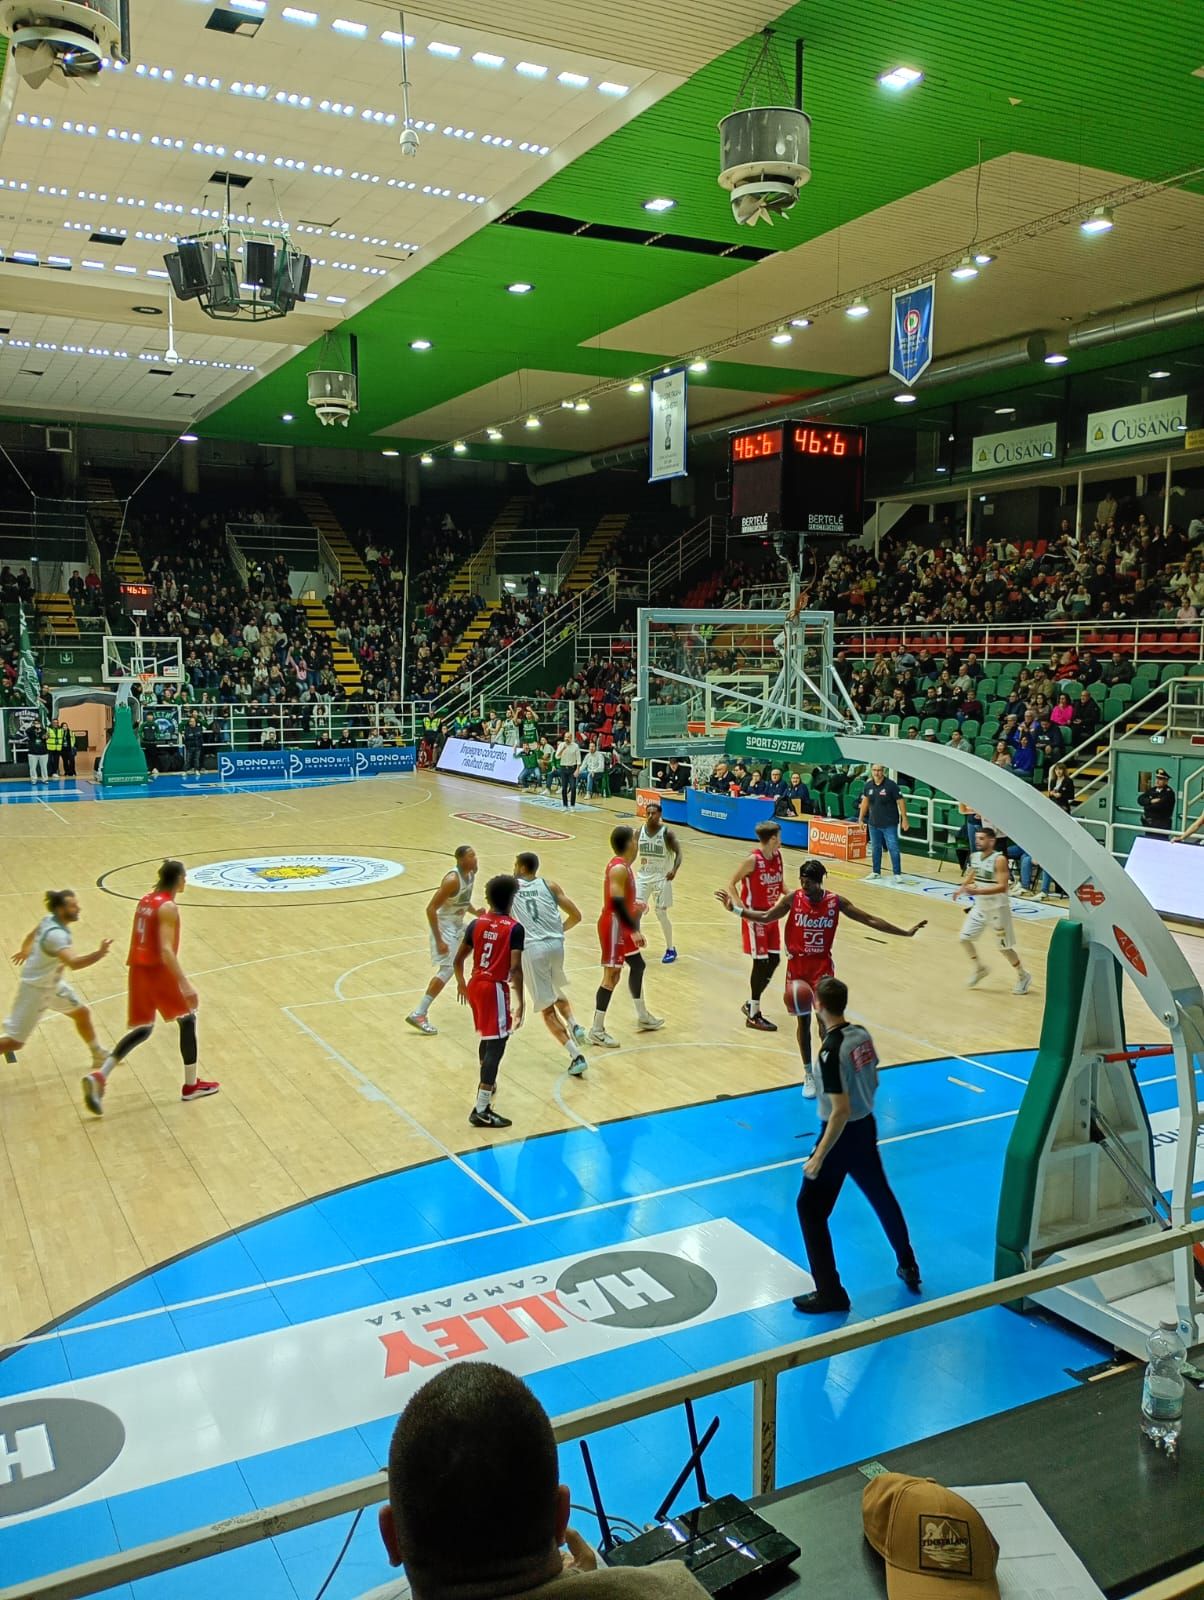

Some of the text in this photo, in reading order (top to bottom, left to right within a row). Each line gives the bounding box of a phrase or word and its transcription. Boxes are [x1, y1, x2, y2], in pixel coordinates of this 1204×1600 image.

[1111, 416, 1183, 443] CUSANO
[993, 440, 1054, 464] CUSANO
[236, 758, 269, 766] BONO
[304, 756, 336, 764] BONO
[370, 754, 399, 762] BONO
[819, 831, 847, 844] DURING
[794, 913, 834, 928] Mestre
[480, 942, 493, 968] 2
[364, 1274, 549, 1327] CAMPANIA
[377, 1266, 676, 1379] HALLEY
